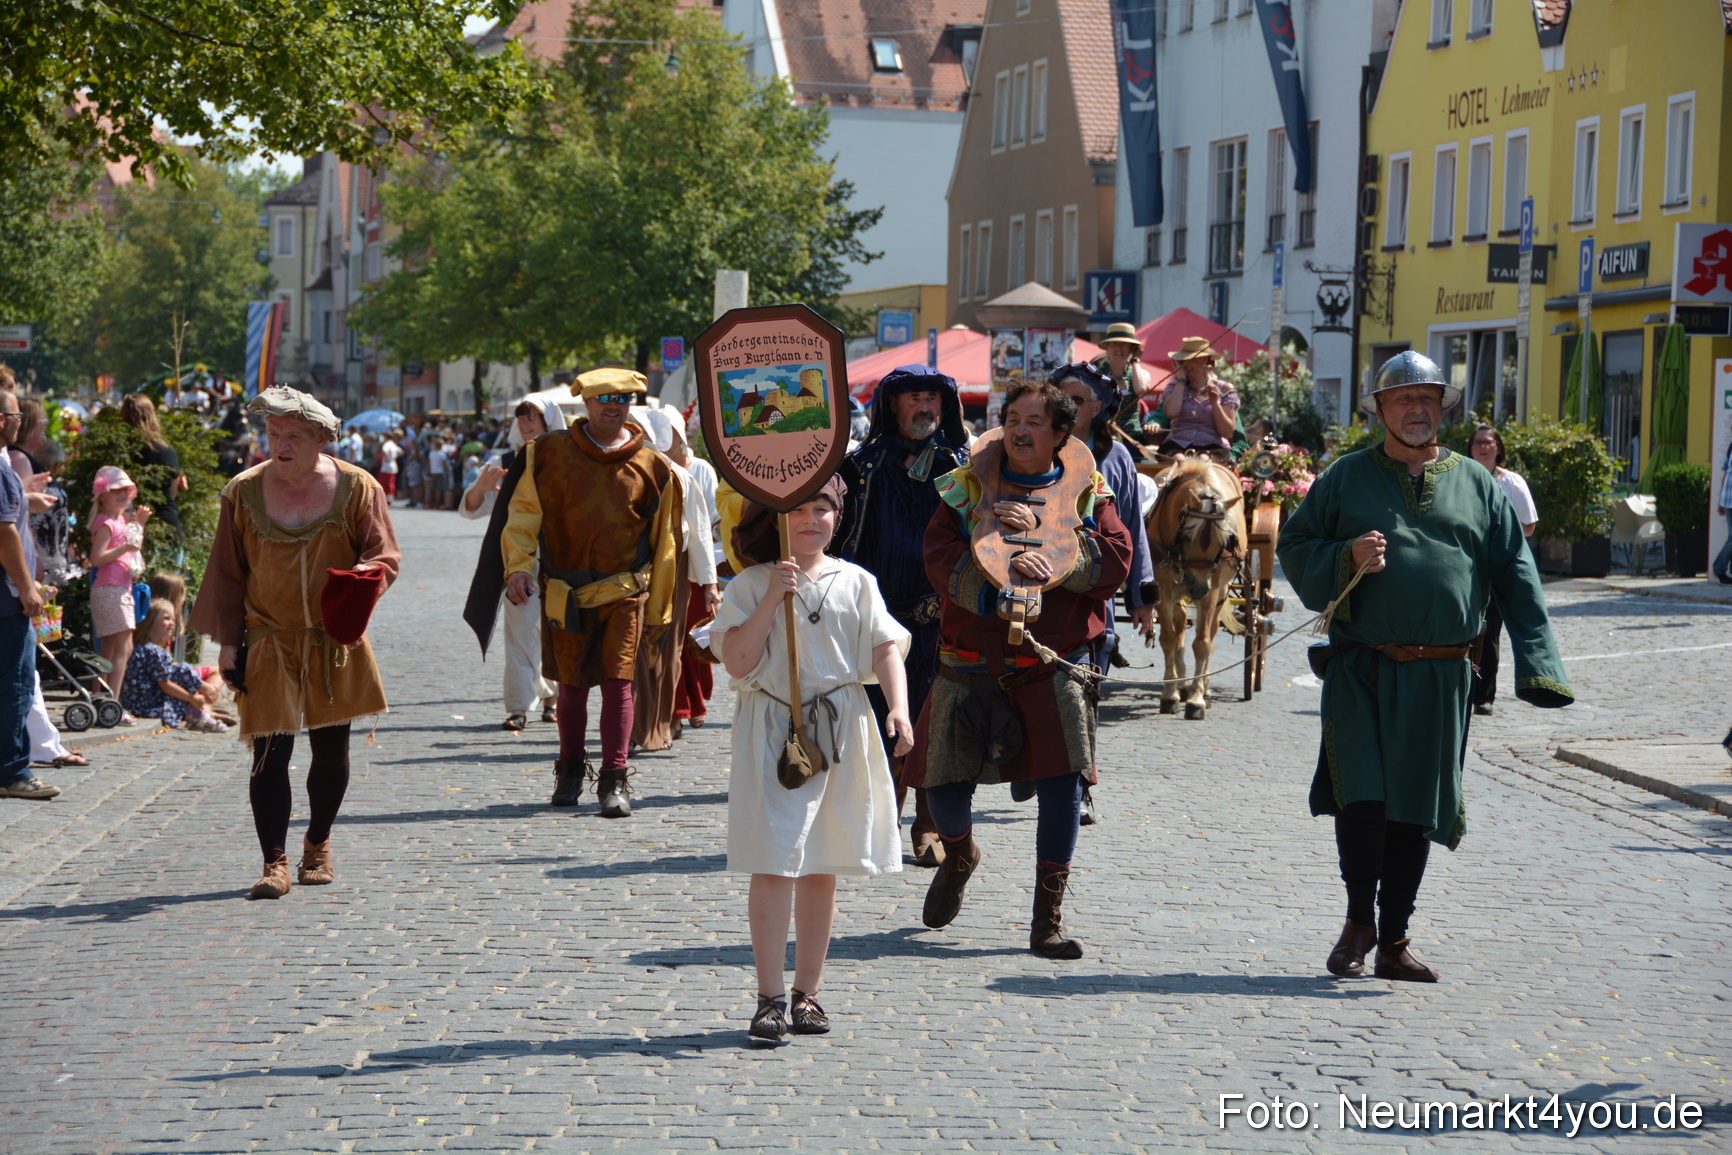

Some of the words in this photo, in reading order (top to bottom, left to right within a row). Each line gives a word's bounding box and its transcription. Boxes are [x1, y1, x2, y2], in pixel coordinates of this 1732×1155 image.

[1448, 86, 1489, 129] HOTEL
[1500, 78, 1550, 115] Lehmeier
[1523, 206, 1531, 247] P
[1580, 245, 1591, 287] P
[1595, 247, 1638, 275] TAIFUN
[1435, 286, 1495, 315] Restaurant
[713, 356, 740, 369] Burg
[743, 348, 802, 366] Burgthann
